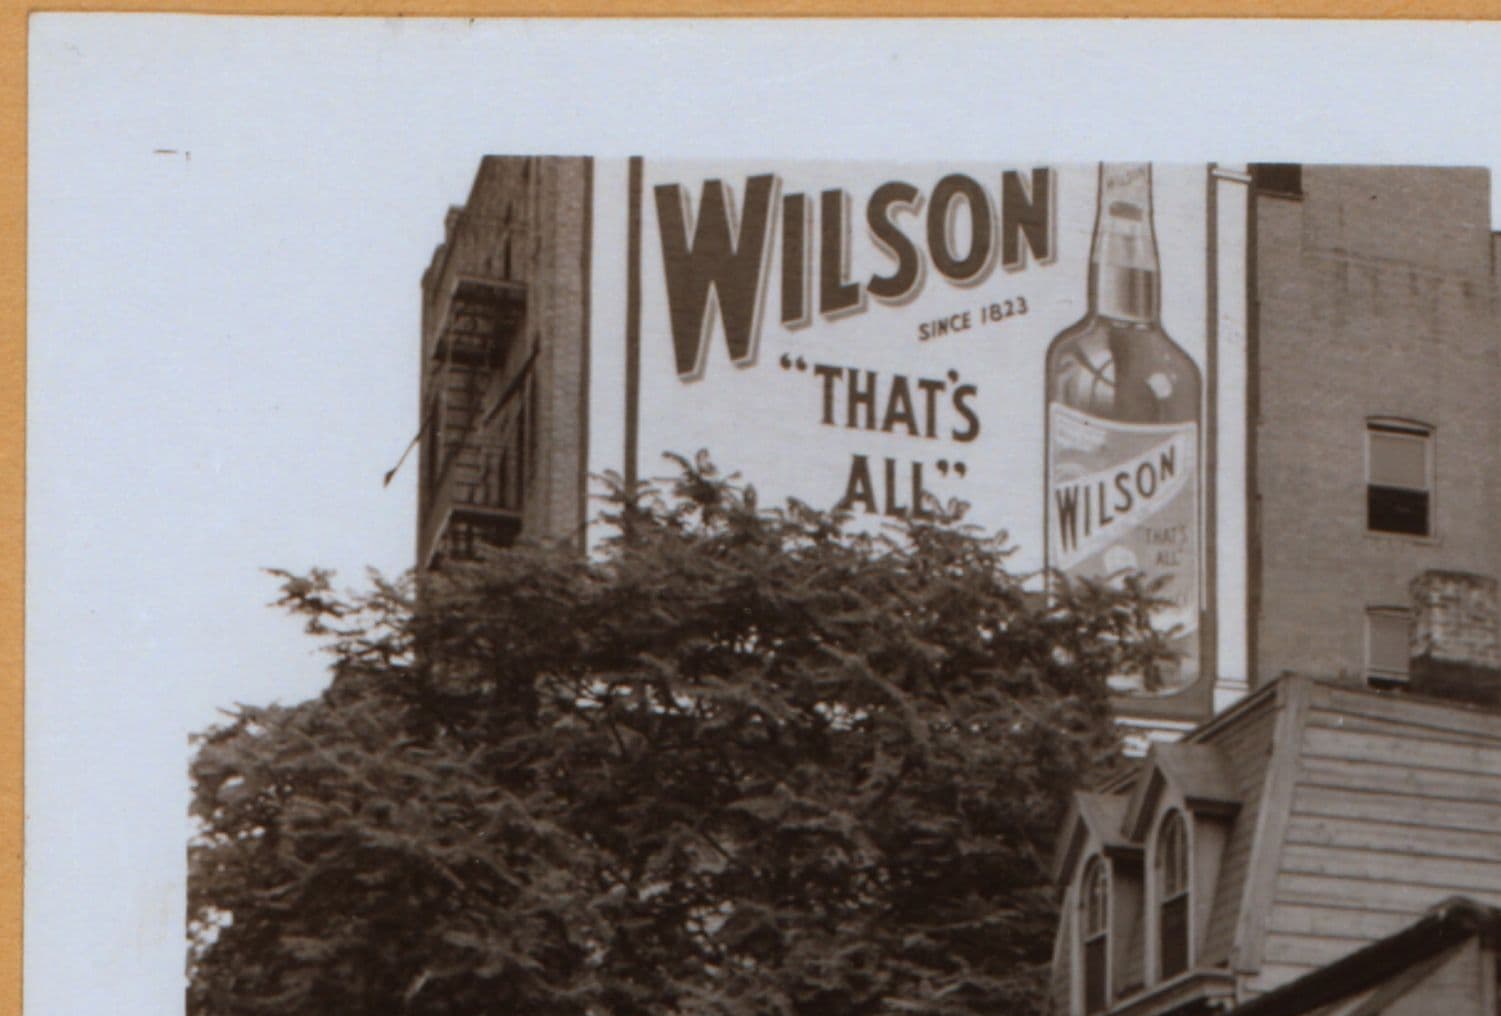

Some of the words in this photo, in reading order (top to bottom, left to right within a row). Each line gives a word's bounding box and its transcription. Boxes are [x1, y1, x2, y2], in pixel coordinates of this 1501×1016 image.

[654, 166, 1057, 383] WILSON
[917, 309, 972, 342] SINCE
[980, 295, 1030, 326] 1823
[1054, 444, 1176, 553] WILSON
